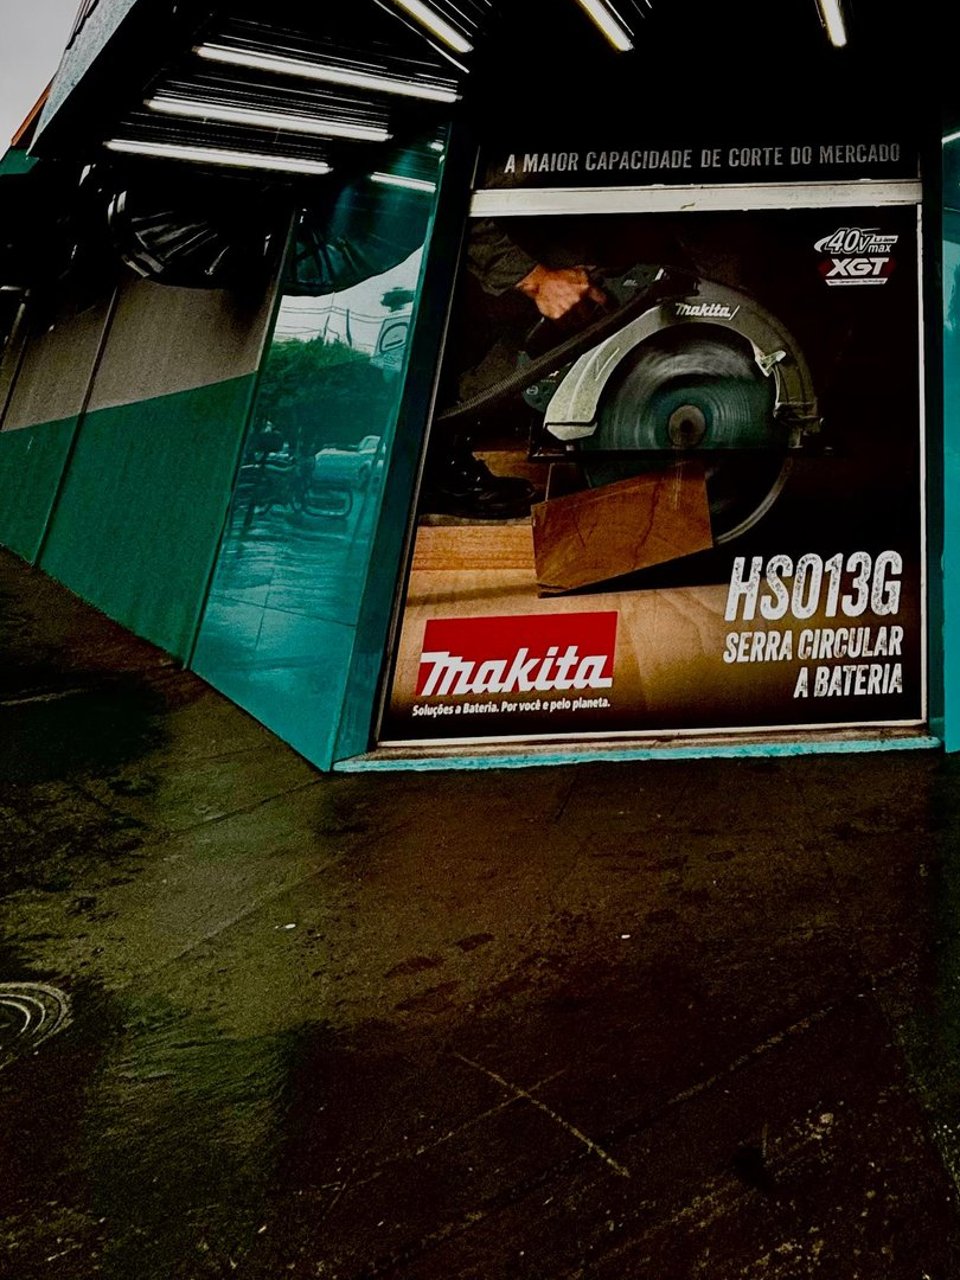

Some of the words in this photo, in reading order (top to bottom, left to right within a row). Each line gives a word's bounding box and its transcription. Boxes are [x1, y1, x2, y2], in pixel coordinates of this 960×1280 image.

[504, 154, 516, 174] A
[523, 151, 579, 173] MAIOR
[585, 149, 693, 171] CAPACIDADE
[701, 148, 722, 168] DE
[728, 146, 784, 167] CORTE
[790, 146, 813, 165] DO
[819, 143, 900, 164] MERCADO
[825, 257, 890, 277] XGT
[724, 550, 903, 621] HS013G
[722, 630, 793, 664] SERRA
[797, 625, 904, 660] CIRCULAR
[420, 645, 613, 697] makita
[793, 666, 809, 698] A
[813, 663, 903, 698] BATERIA
[412, 703, 454, 718] Soluções
[455, 705, 462, 715] a
[463, 701, 500, 714] Bateria.
[501, 700, 517, 712] Por
[519, 698, 541, 711] você
[542, 702, 549, 711] e
[550, 697, 571, 713] pelo
[572, 697, 611, 711] planeta.
